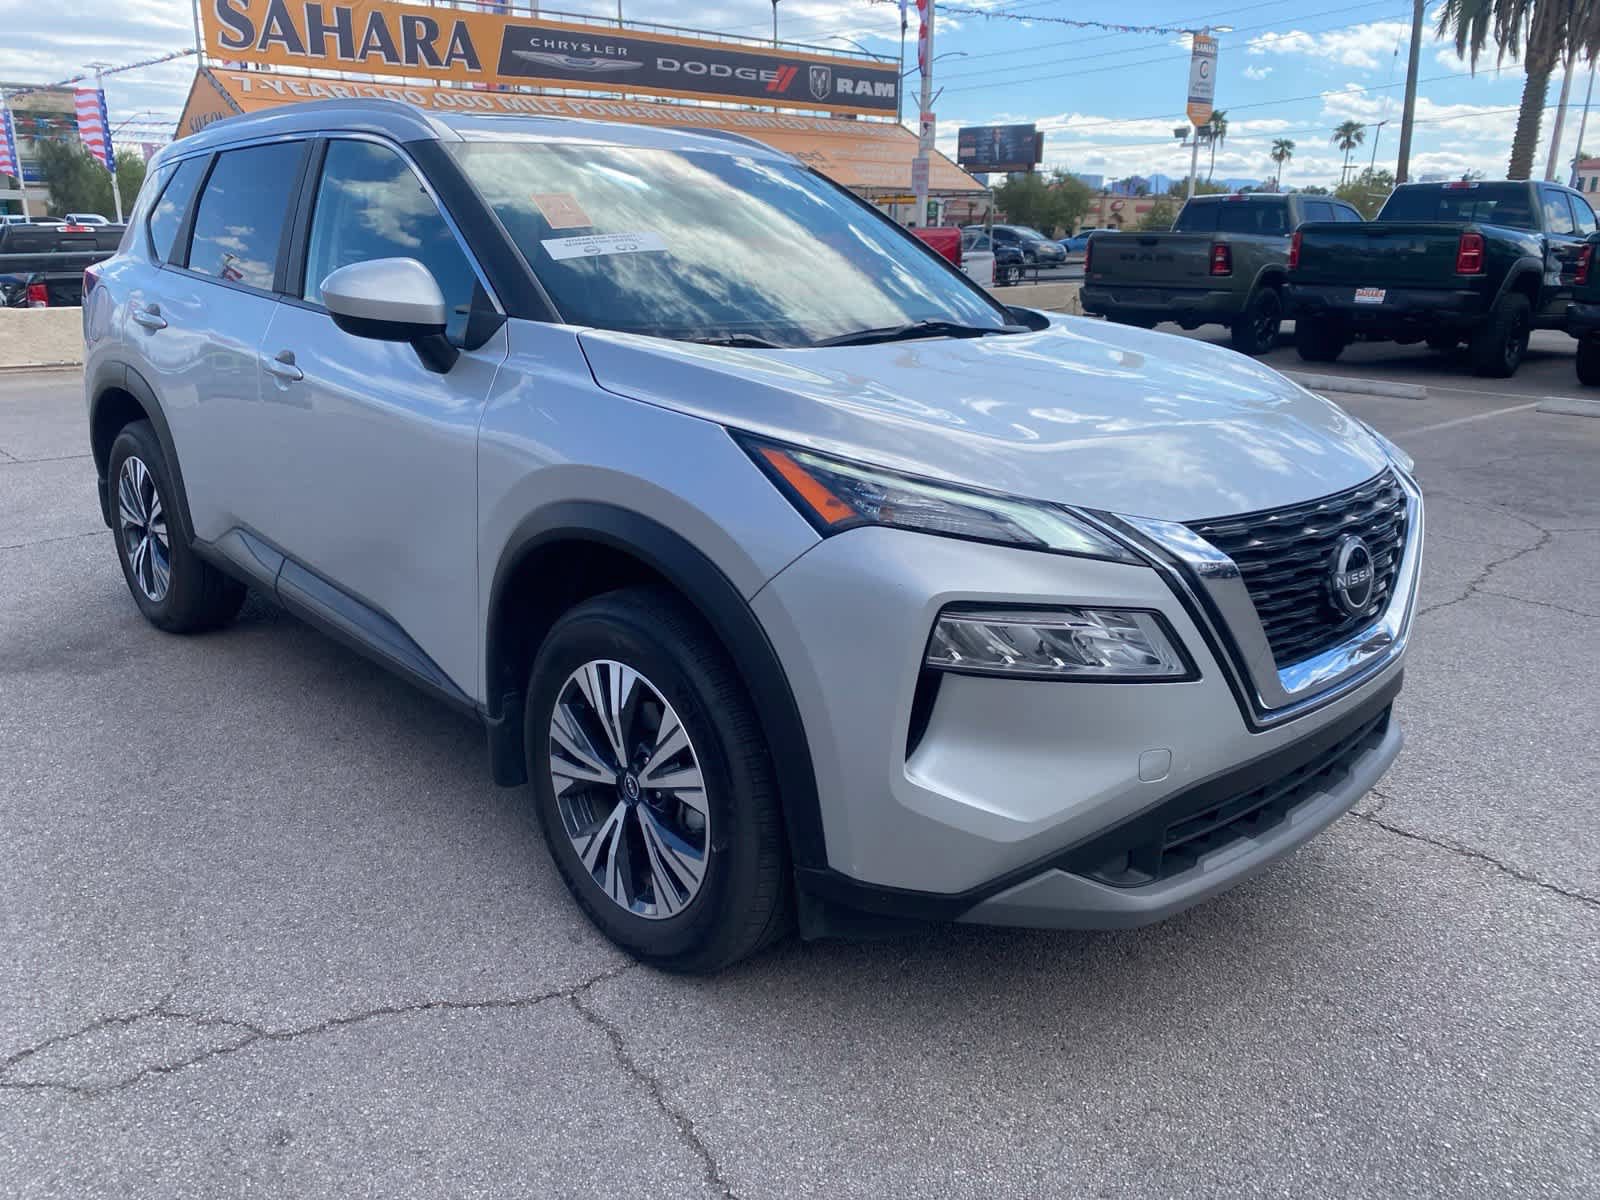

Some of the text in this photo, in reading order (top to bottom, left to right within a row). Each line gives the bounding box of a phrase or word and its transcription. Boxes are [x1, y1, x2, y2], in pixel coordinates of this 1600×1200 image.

[215, 0, 483, 74] SAHARA
[529, 37, 629, 57] CHRYSLER
[656, 57, 780, 83] DODGE
[836, 77, 896, 98] RAM
[495, 95, 568, 113] MILE
[565, 101, 728, 125] POWERTRAIN
